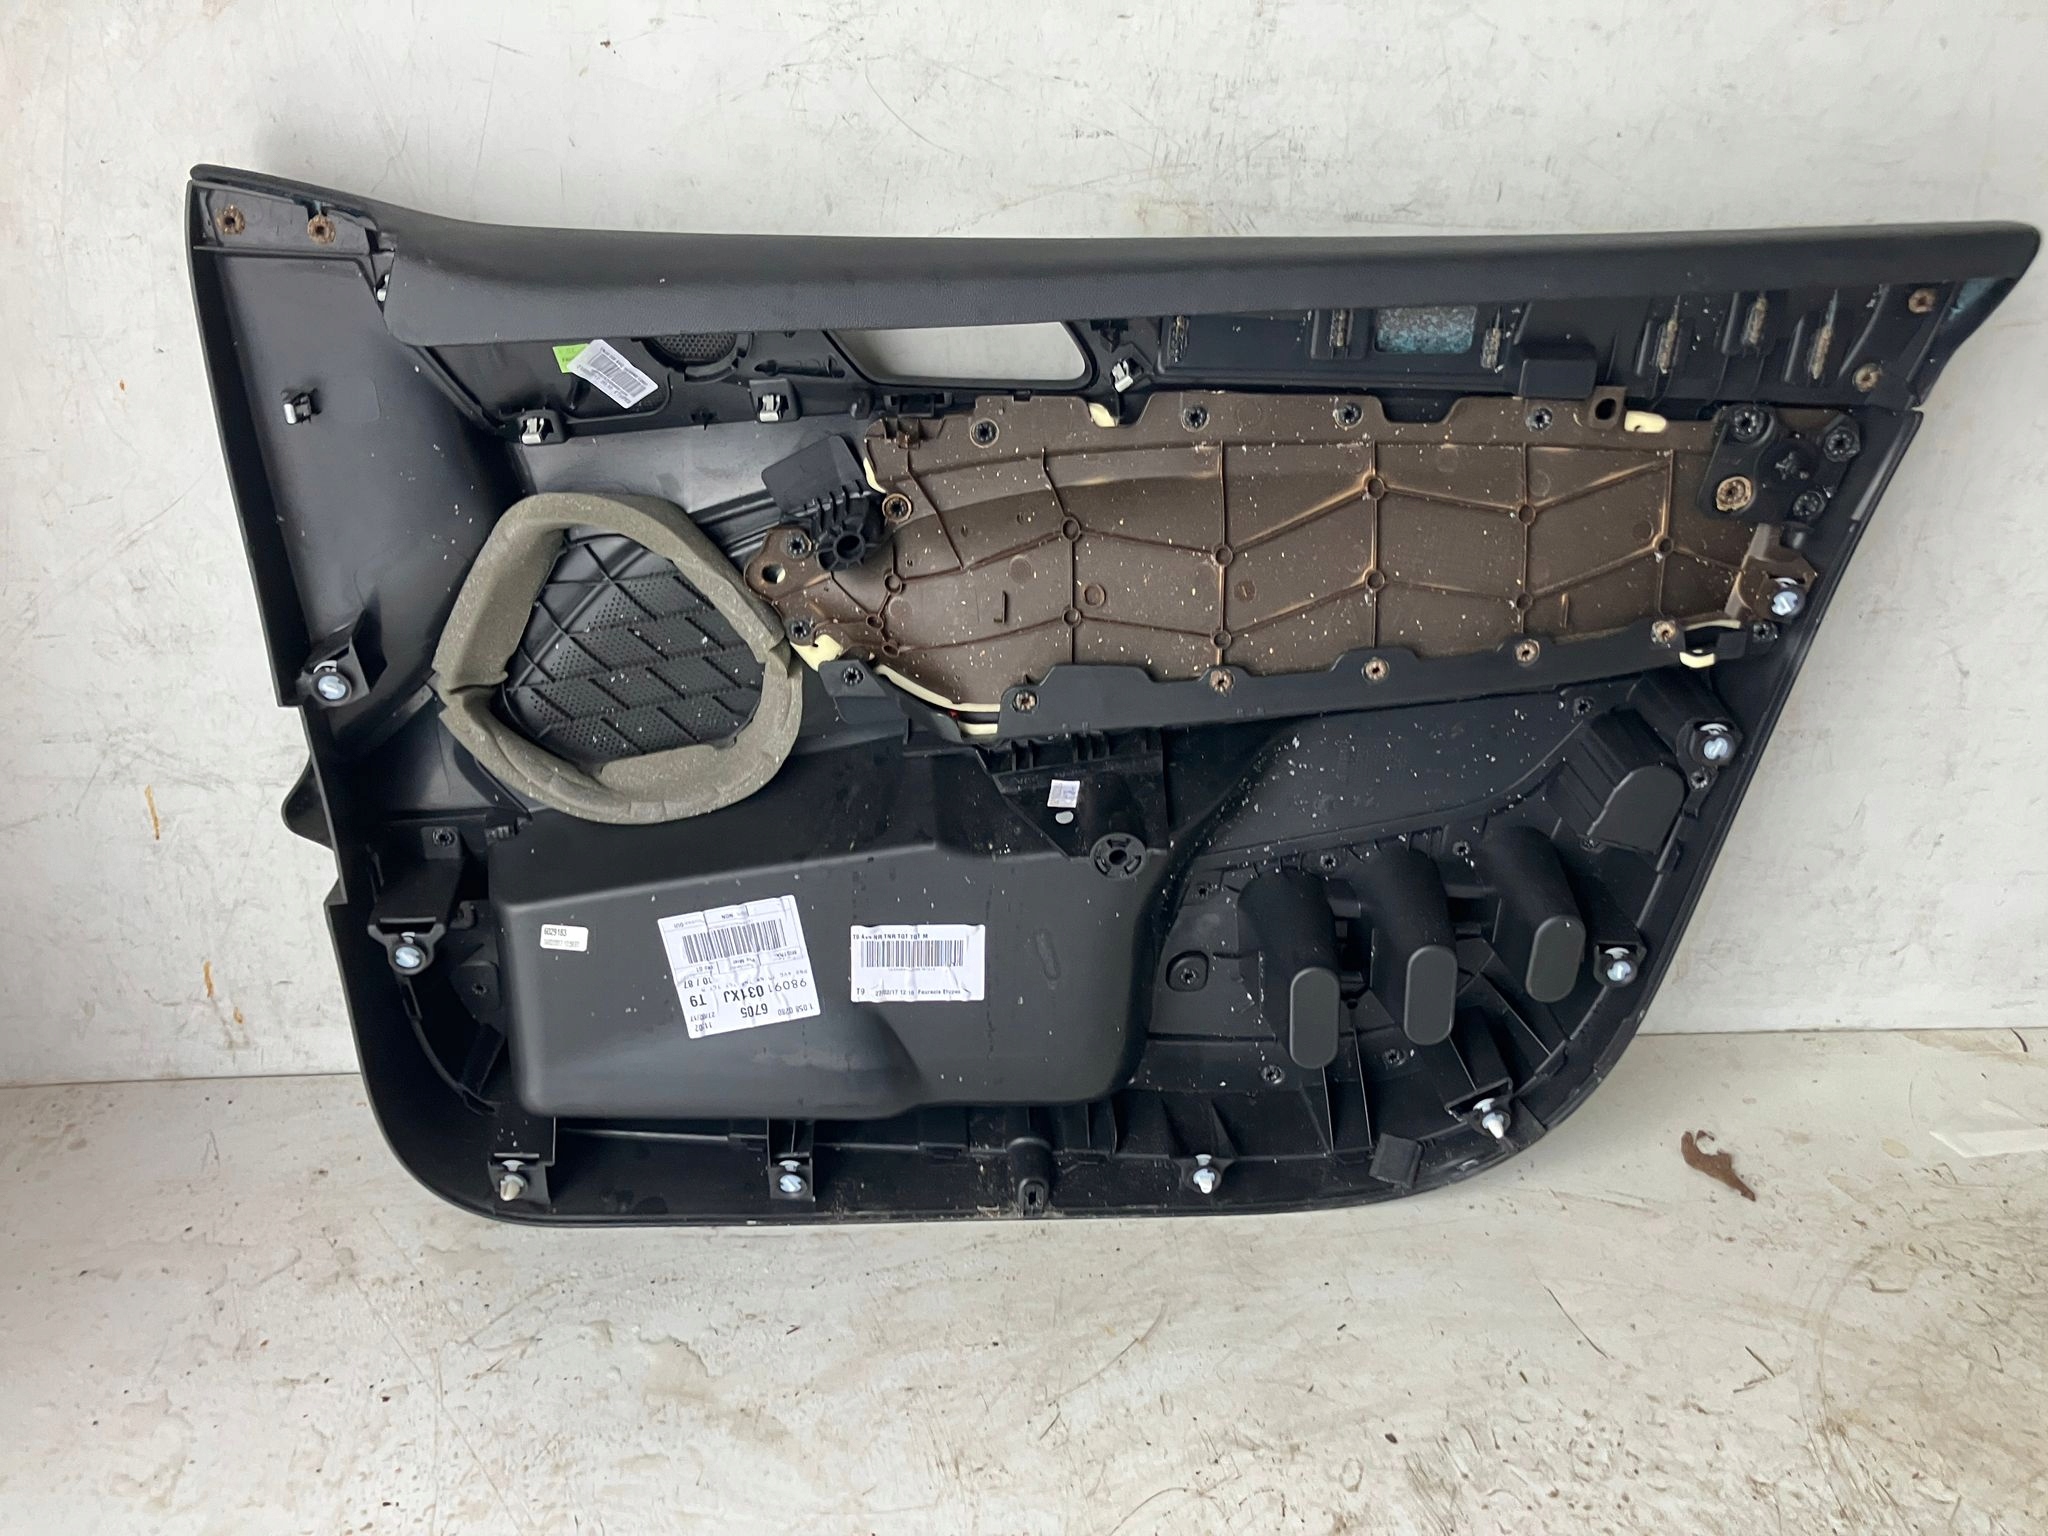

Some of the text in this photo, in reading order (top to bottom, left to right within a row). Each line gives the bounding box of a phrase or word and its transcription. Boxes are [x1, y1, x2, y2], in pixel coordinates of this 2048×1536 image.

[682, 980, 693, 989] 87
[723, 977, 806, 1002] 98091 031XJ
[688, 994, 706, 1007] T9
[740, 1002, 768, 1017] 6705
